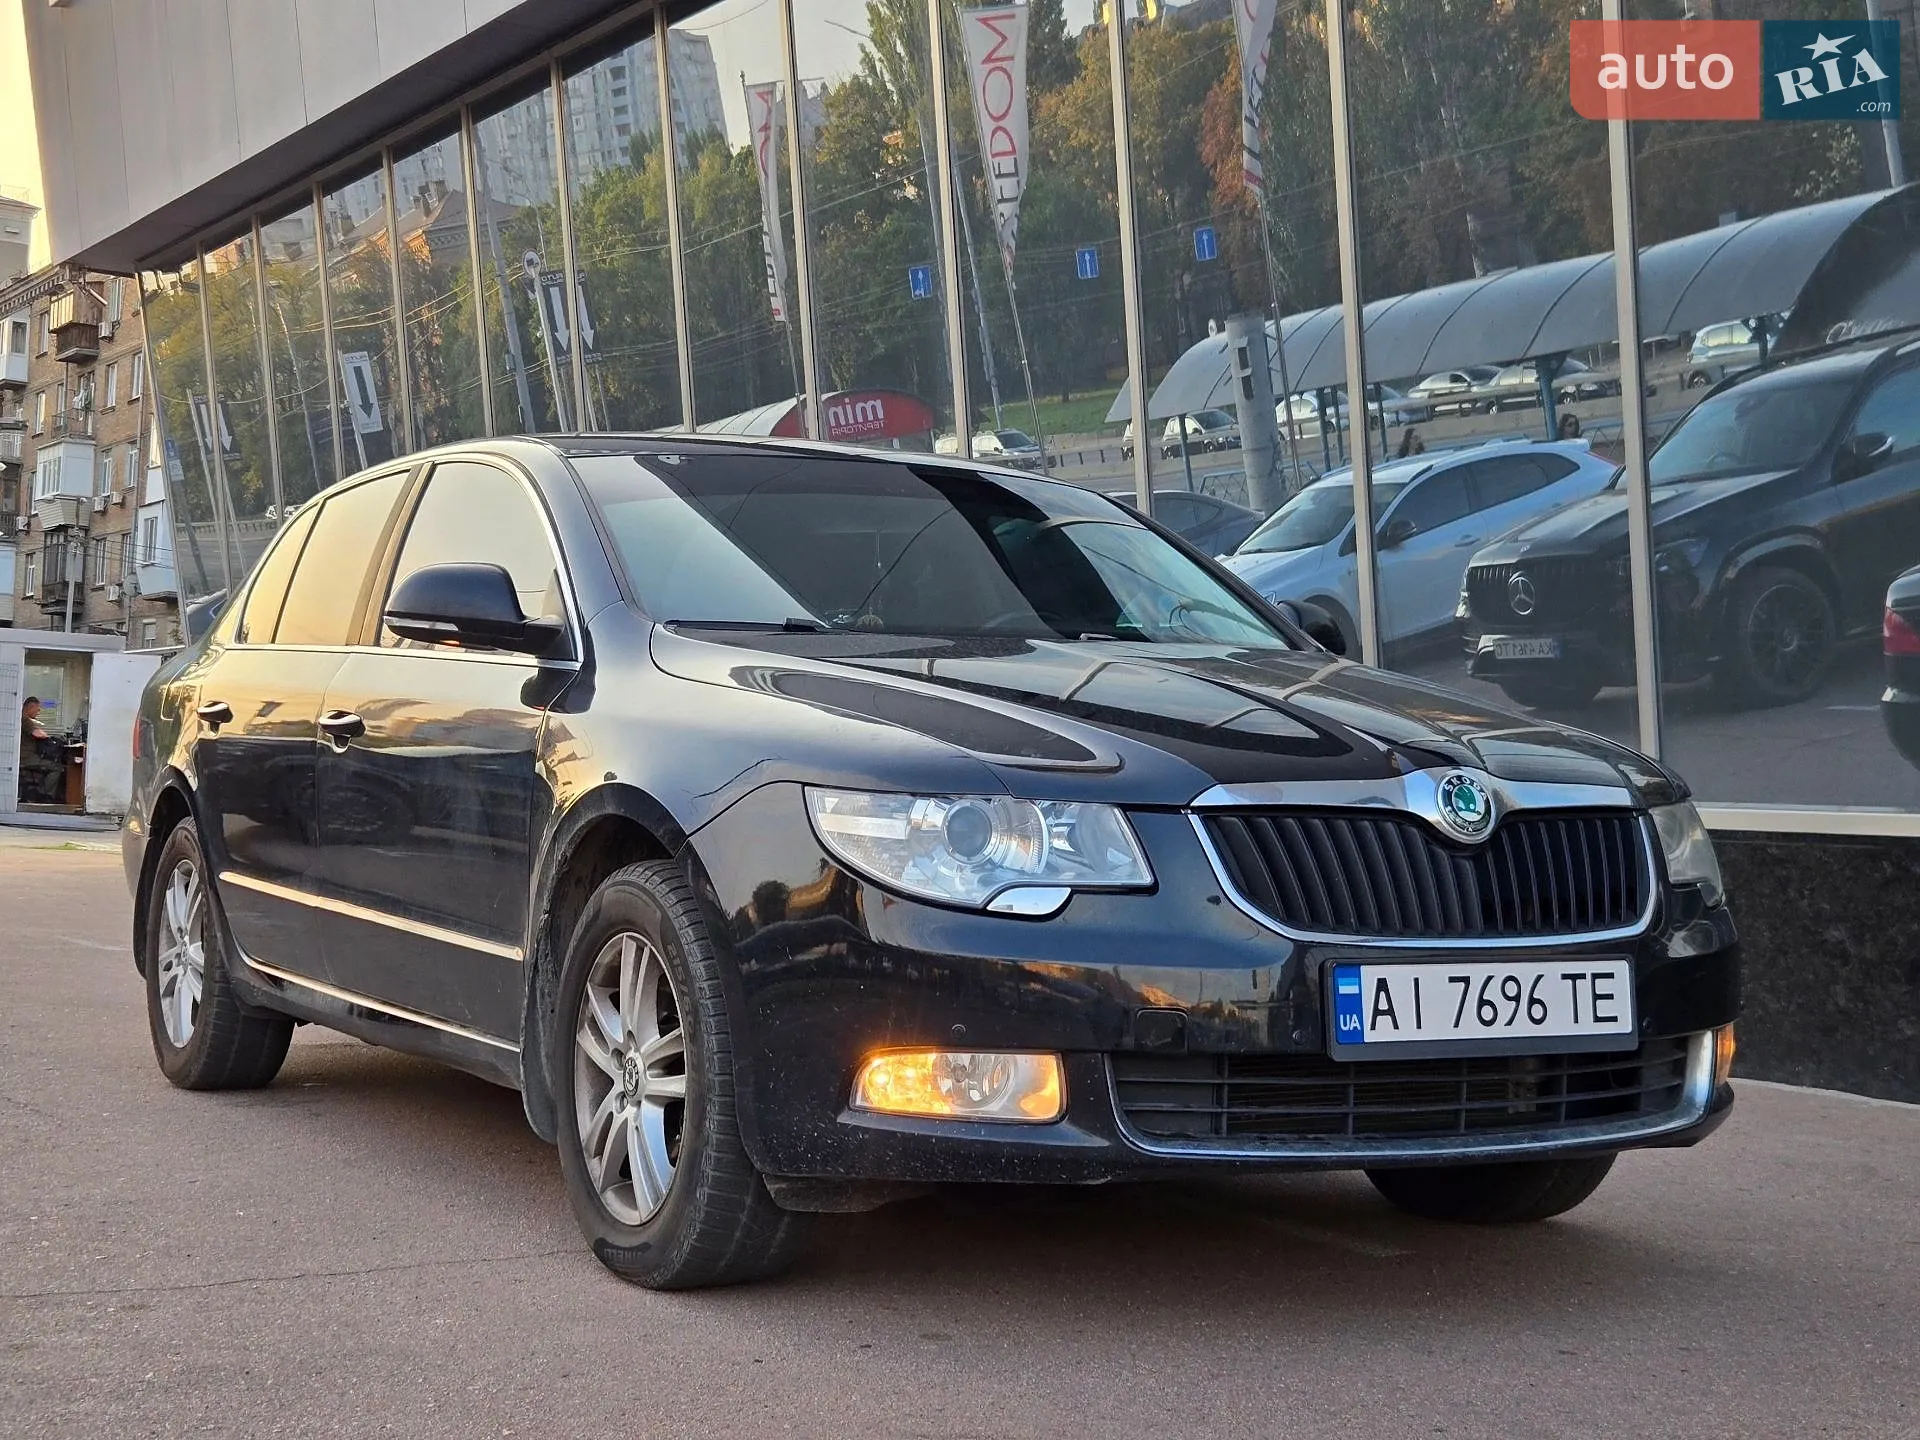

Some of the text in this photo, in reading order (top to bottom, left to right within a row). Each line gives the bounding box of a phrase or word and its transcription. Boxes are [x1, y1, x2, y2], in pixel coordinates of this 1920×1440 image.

[1369, 972, 1618, 1031] AI 7696 TE
[1339, 1014, 1362, 1031] UA
